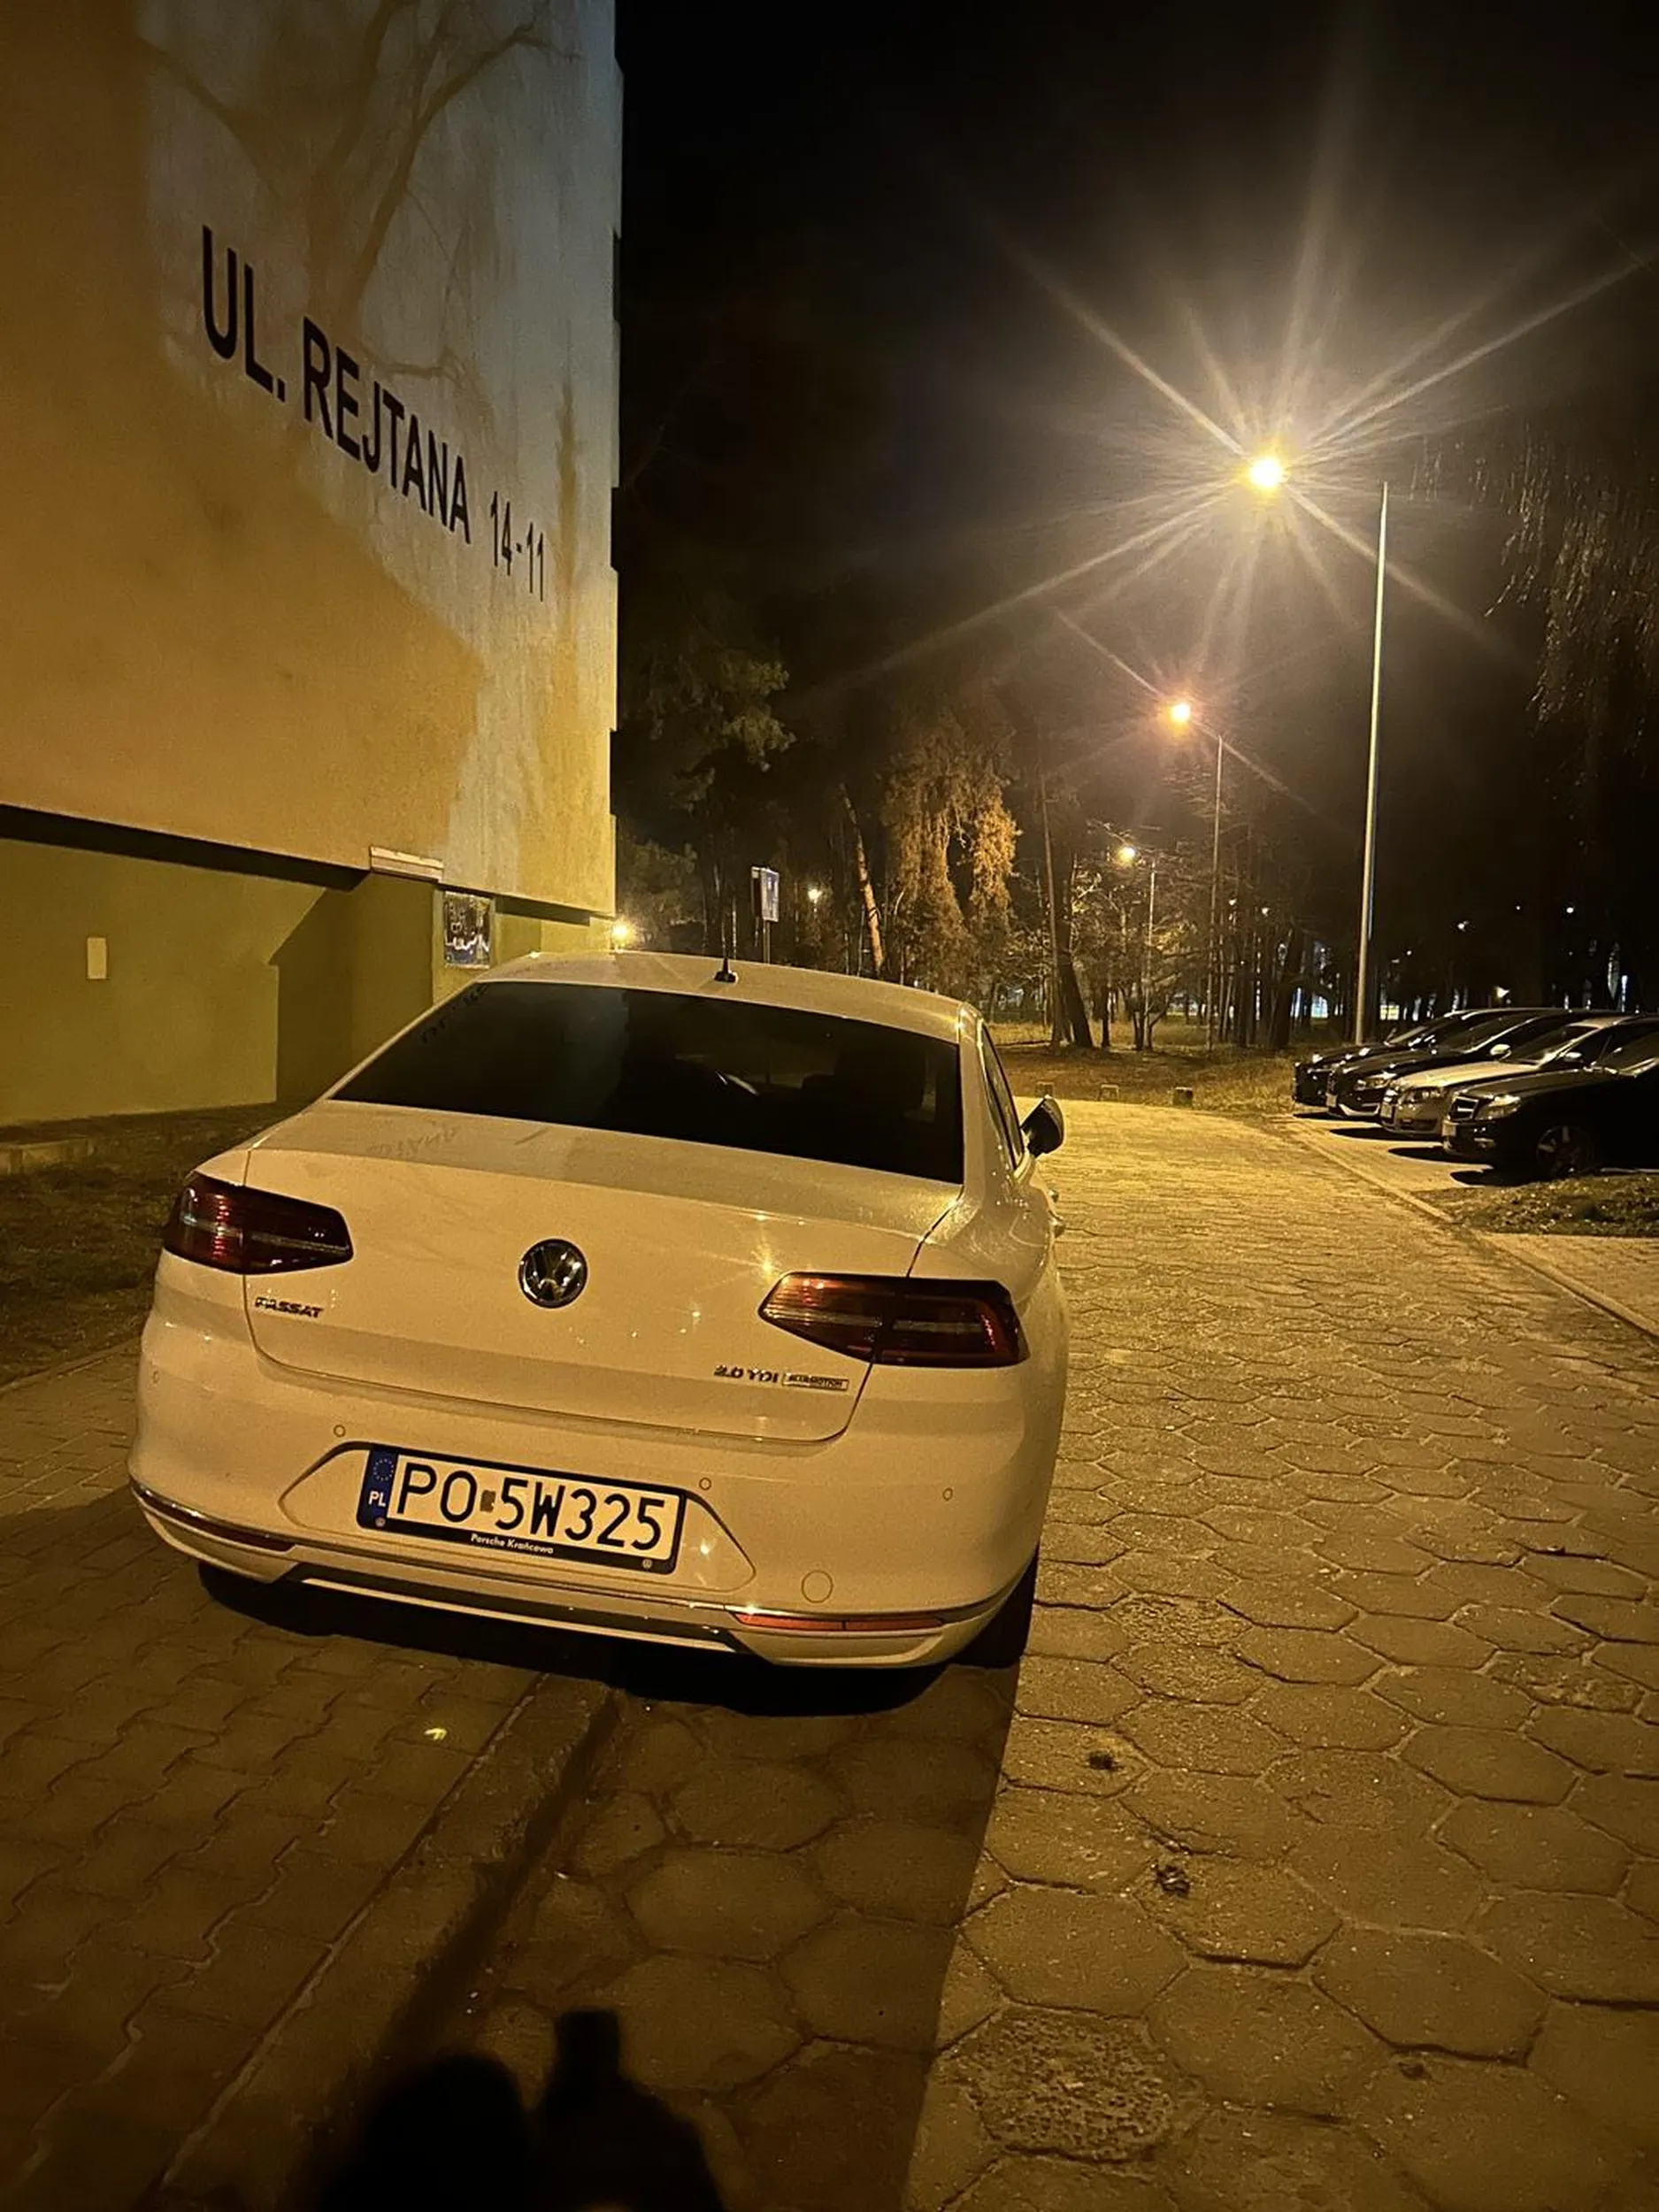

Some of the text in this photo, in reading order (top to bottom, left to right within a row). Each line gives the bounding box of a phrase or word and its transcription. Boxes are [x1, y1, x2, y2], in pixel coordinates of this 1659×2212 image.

[202, 225, 545, 602] UL. REJTANA 14-11
[255, 1296, 325, 1318] PASSAT
[714, 1364, 744, 1379] 2.0
[367, 1490, 387, 1508] PL
[396, 1463, 665, 1551] PO 5W325
[470, 1532, 506, 1548] Porsche
